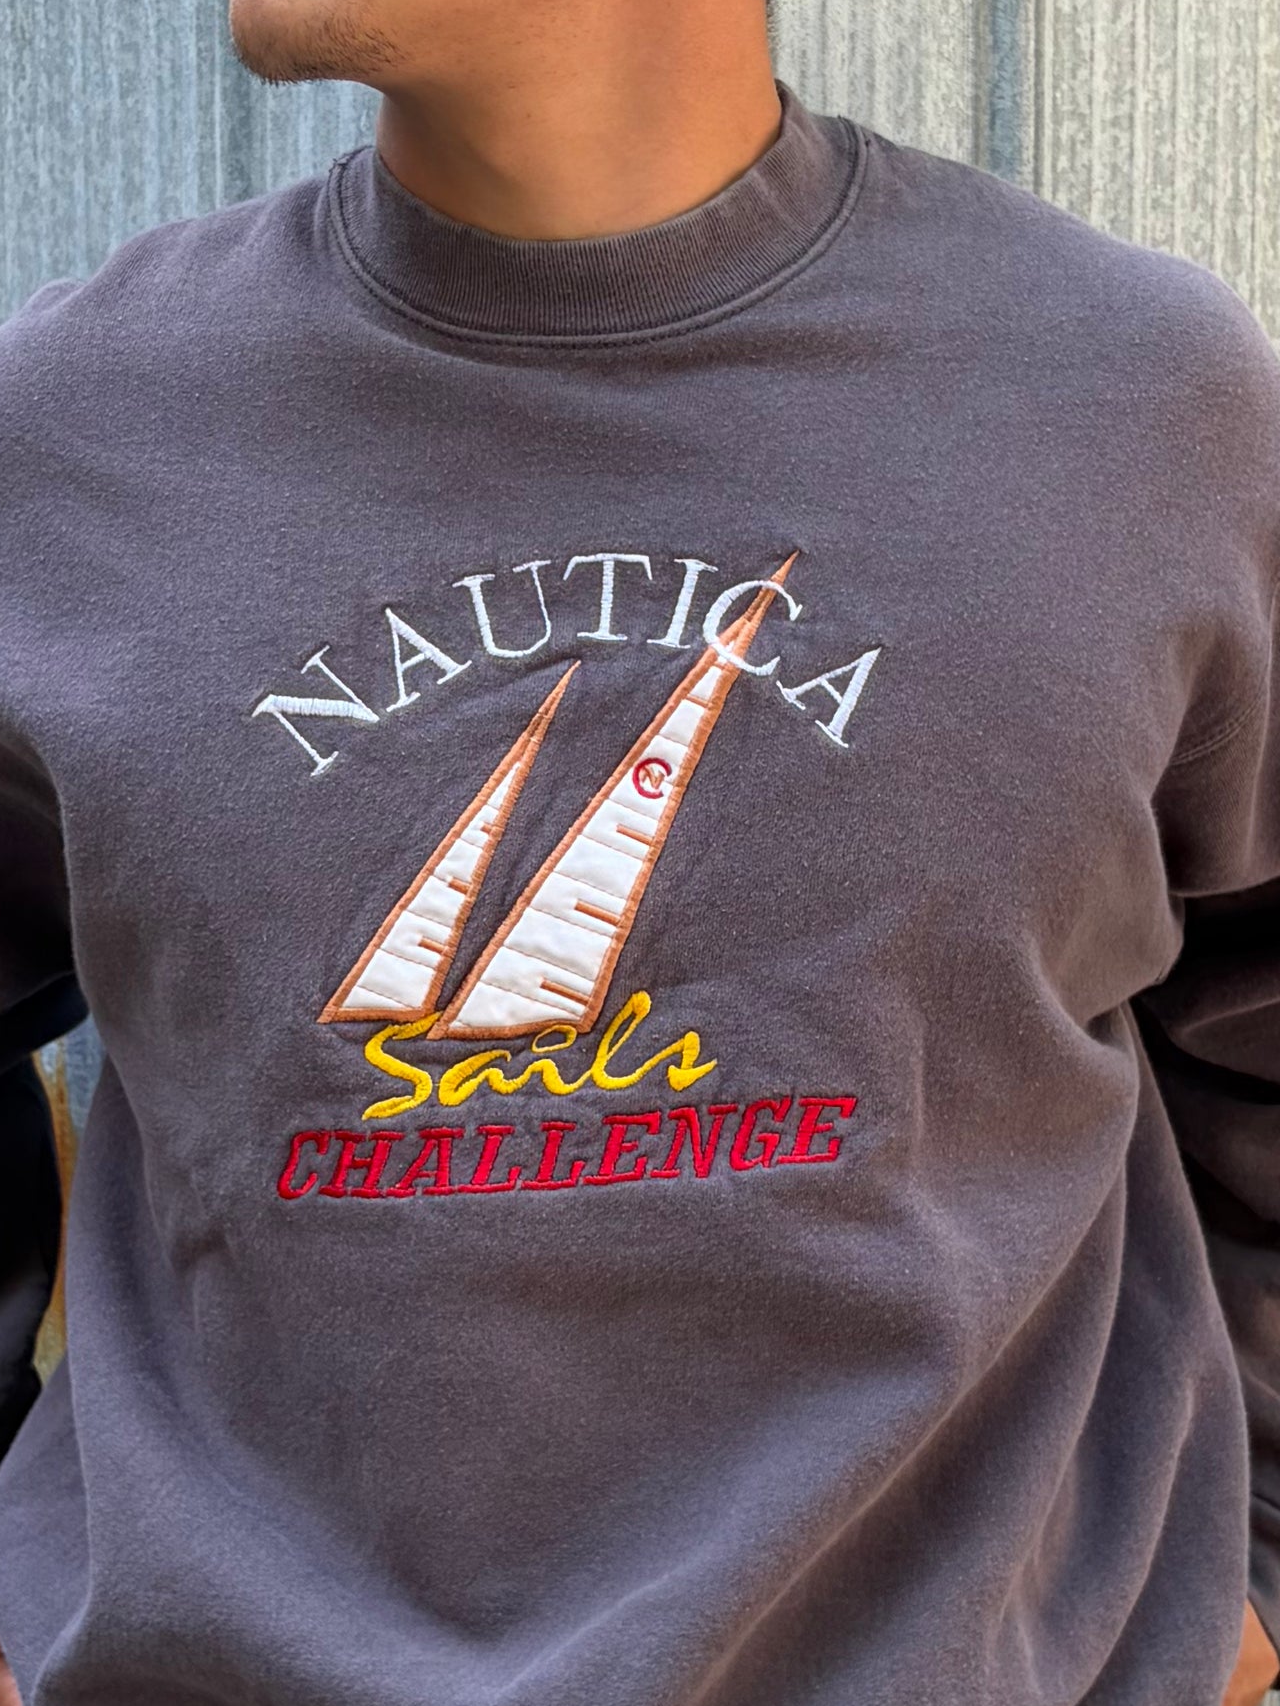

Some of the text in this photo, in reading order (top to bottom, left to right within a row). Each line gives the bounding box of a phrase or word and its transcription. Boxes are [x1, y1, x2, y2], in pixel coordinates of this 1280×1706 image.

[252, 552, 883, 777] NAUTICA
[361, 990, 717, 1121] Sails
[276, 1095, 858, 1202] CHALLENGE
